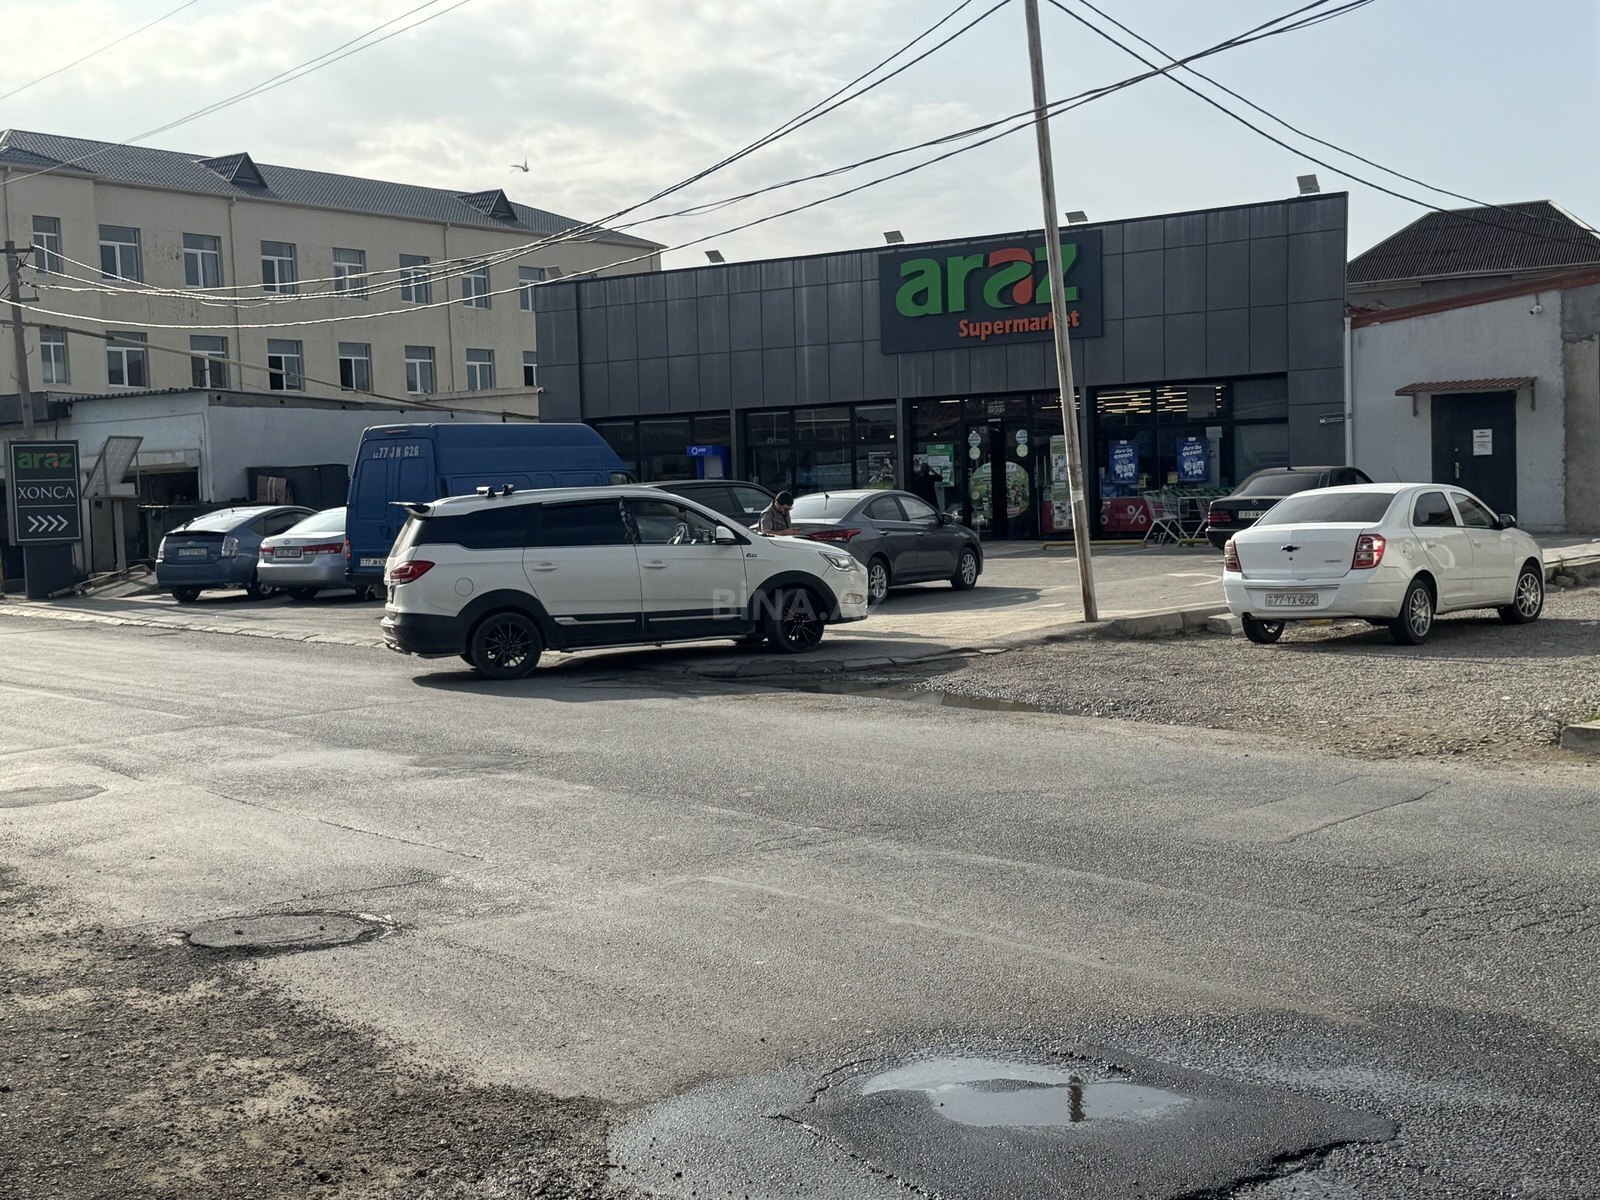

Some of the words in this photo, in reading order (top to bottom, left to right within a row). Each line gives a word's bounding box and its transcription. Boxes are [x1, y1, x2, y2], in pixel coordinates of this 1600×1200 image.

[896, 243, 1079, 317] araz
[959, 310, 1080, 341] Supermart
[17, 452, 72, 469] araz
[379, 447, 388, 458] 77
[404, 446, 419, 457] 626
